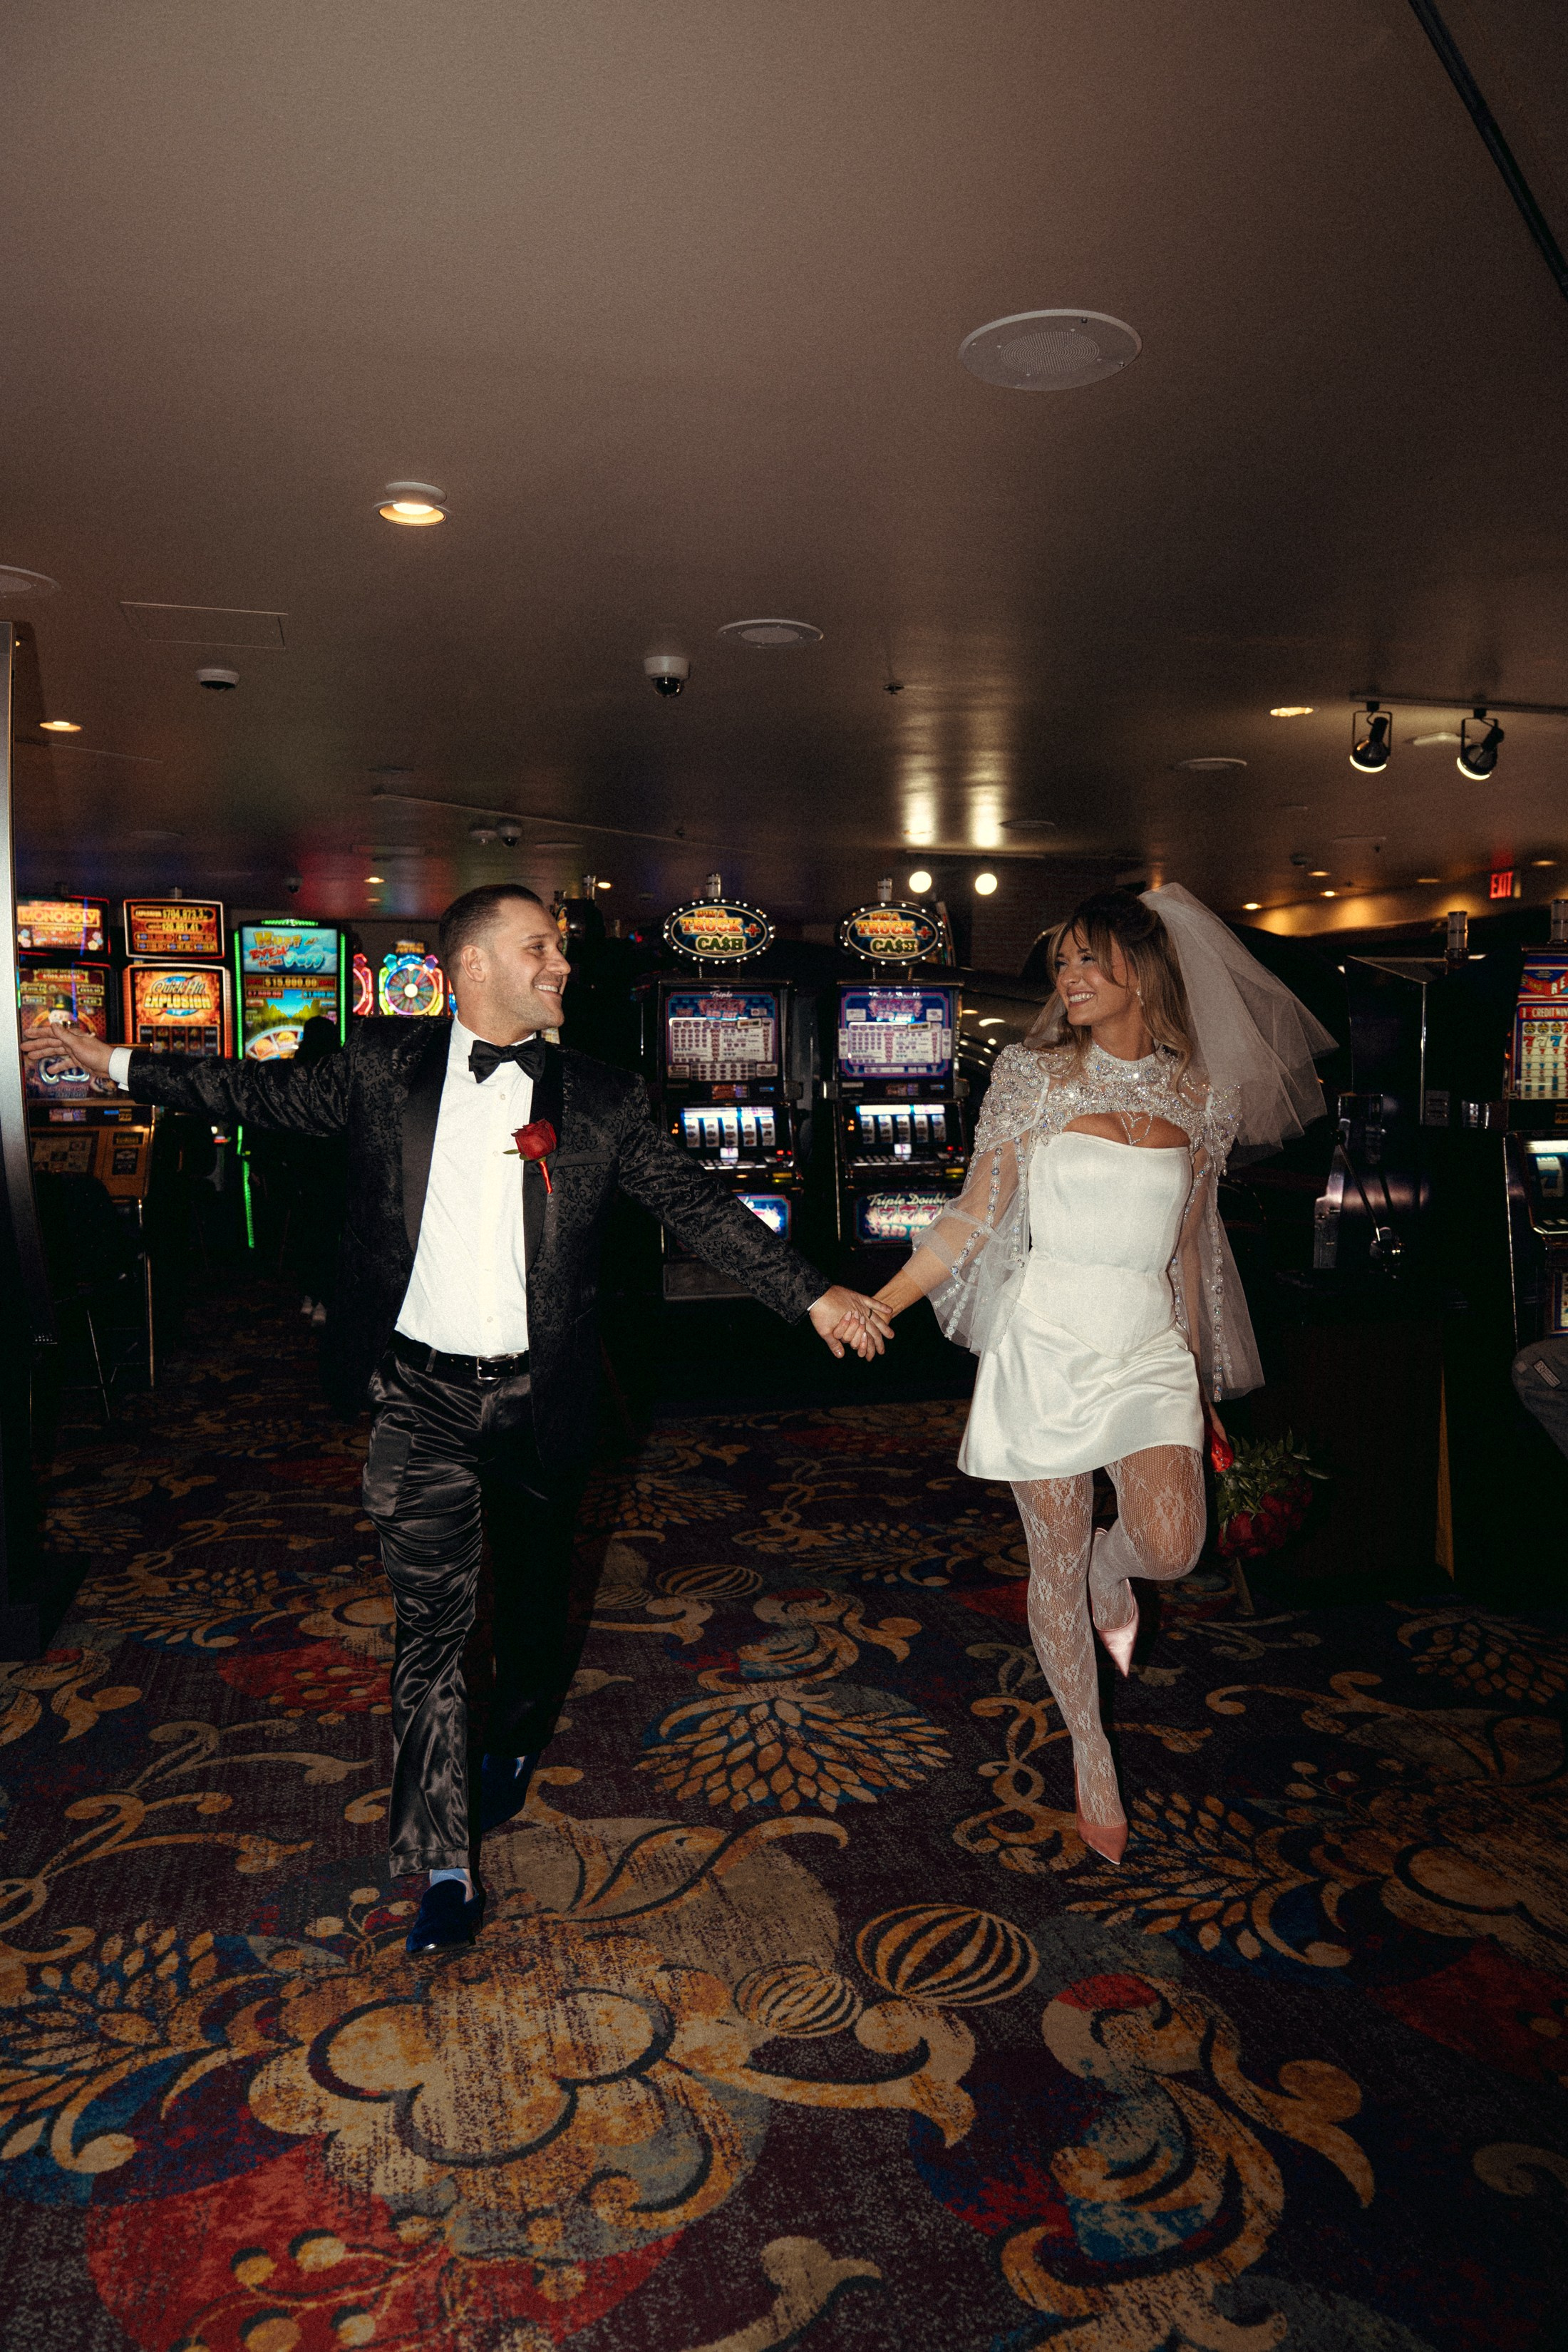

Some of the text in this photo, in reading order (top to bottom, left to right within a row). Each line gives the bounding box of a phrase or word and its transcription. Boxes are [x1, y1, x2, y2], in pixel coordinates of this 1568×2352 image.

[1490, 871, 1513, 899] EXIT
[21, 910, 98, 923] MONOPOLY
[681, 917, 742, 933] TRUCK
[856, 921, 914, 934] TRUCK
[144, 994, 212, 1009] EXPLOSION
[709, 990, 733, 999] Triple
[867, 1192, 906, 1209] Triple
[880, 1224, 907, 1238] RED
